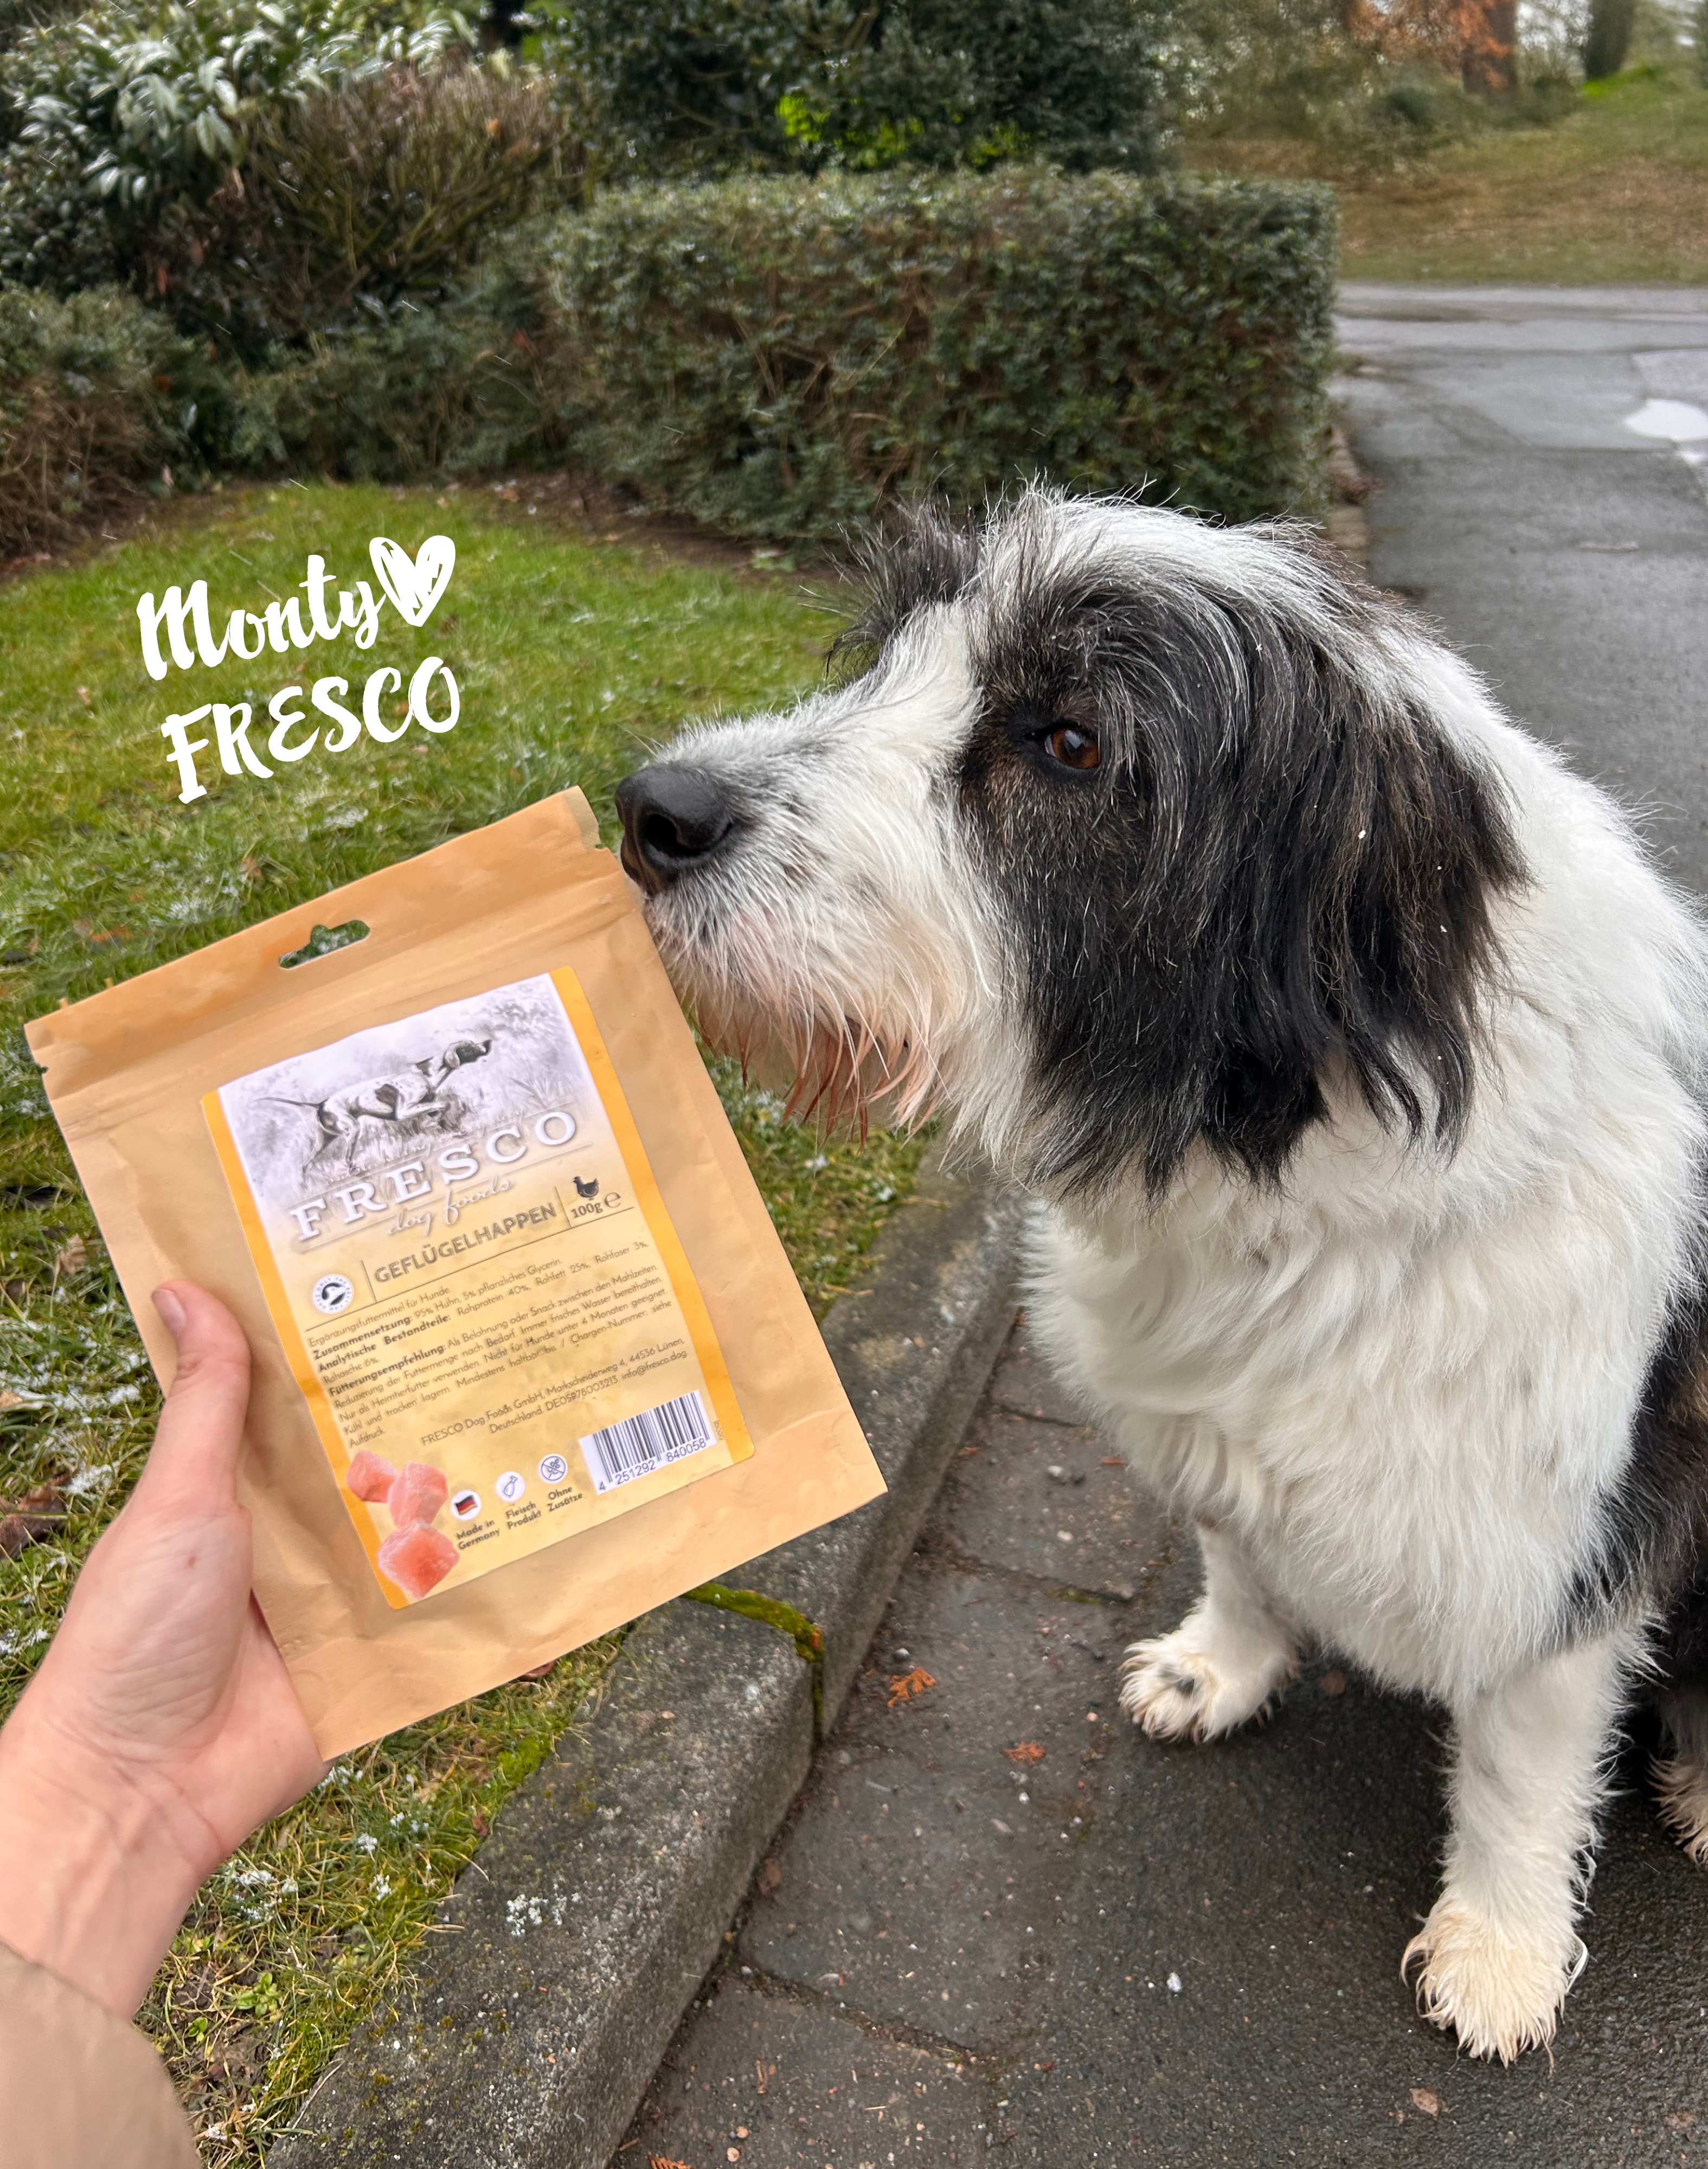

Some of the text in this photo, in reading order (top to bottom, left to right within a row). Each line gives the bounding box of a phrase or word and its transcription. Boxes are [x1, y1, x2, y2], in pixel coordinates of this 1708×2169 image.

[288, 1111, 577, 1242] FRESCO
[388, 1173, 513, 1235] dog foods
[571, 1199, 602, 1219] 100g
[373, 1201, 557, 1285] GEFLÜGELHAPPEN
[309, 1301, 405, 1348] Ergänzungsfuttermittel
[405, 1297, 419, 1308] für
[313, 1314, 413, 1361] Zusammensetzung:
[414, 1305, 434, 1318] 95%
[434, 1295, 462, 1311] Huhn,
[463, 1289, 477, 1300] 5%
[477, 1270, 526, 1296] pflanzliches
[318, 1239, 649, 1373] Analytische Bestandteile: Rohprotein 40%, Rohfett 25%, Rohfaser 3%,
[329, 1343, 446, 1397] Fütterungsempfehlung:
[447, 1336, 461, 1348] Als
[461, 1319, 509, 1343] Belohnung
[509, 1310, 529, 1324] oder
[529, 1299, 556, 1316] Snack
[557, 1287, 594, 1306] zwischen
[594, 1280, 611, 1292] den
[334, 1383, 384, 1410] Reduzierung
[386, 1375, 401, 1387] der
[404, 1352, 459, 1380] Futtermenge
[461, 1342, 484, 1357] nach
[519, 1318, 548, 1334] Immer
[550, 1306, 580, 1323] frisches
[581, 1294, 611, 1310] Wasser
[339, 1409, 356, 1422] Nur
[358, 1402, 370, 1414] als
[371, 1378, 430, 1407] Heimtierfutter
[483, 1346, 508, 1362] Nicht
[525, 1329, 555, 1346] Hunde
[557, 1320, 579, 1334] unter
[581, 1316, 588, 1325] 4
[590, 1301, 628, 1321] Monaten
[366, 1410, 382, 1425] und
[385, 1397, 418, 1416] trocken
[455, 1363, 505, 1388] Mindestens
[543, 1343, 557, 1354] bis
[651, 1299, 672, 1313] siehe
[323, 1362, 362, 1384] Rohasche
[420, 1336, 685, 1446] FRESCO Dog Foods GmbH, Markscheiderweg 4, 44536 Lünen,
[547, 1485, 573, 1500] Ohne
[598, 1437, 707, 1491] 4 251292 840058
[455, 1518, 495, 1540] Made in
[505, 1500, 537, 1519] Fleisch
[506, 1509, 542, 1530] Produkt
[546, 1491, 583, 1512] Zusätze
[457, 1526, 500, 1551] Germany
